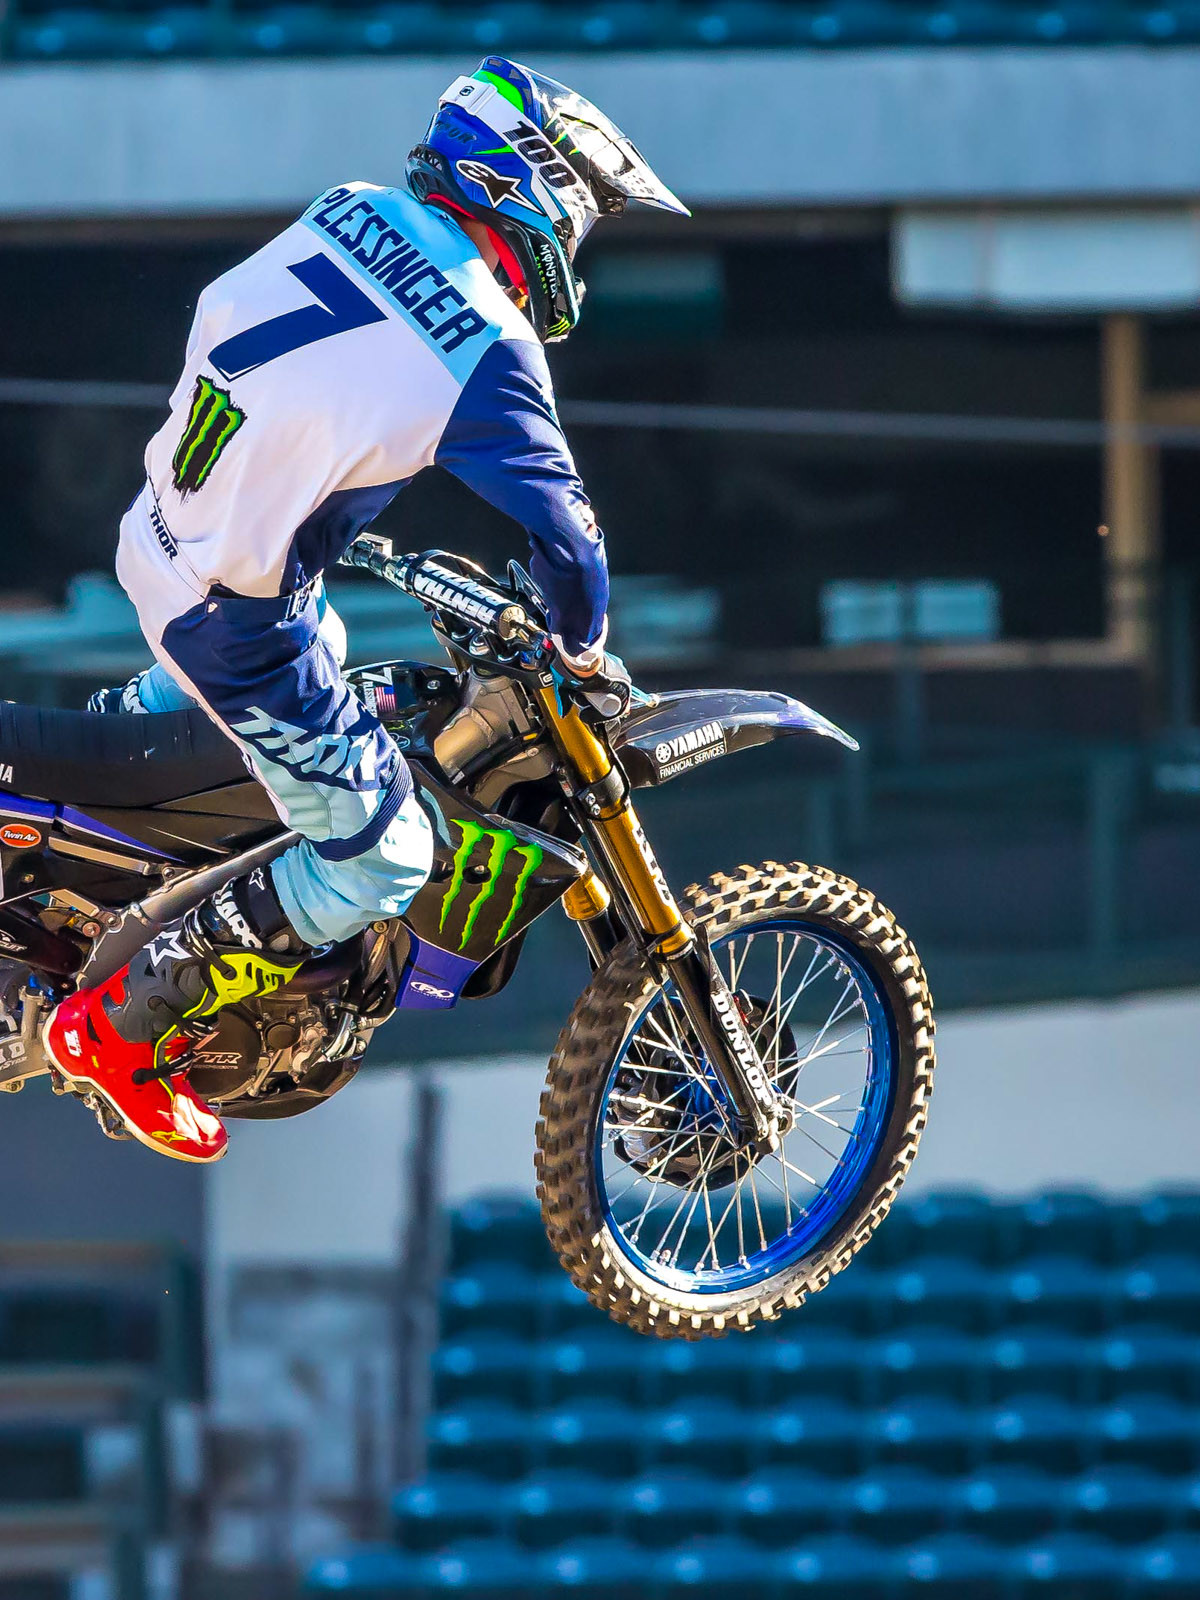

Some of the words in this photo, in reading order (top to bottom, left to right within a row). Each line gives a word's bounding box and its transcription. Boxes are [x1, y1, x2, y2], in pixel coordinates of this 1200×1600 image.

[312, 187, 489, 354] PLESSINGER
[208, 251, 389, 383] 7
[150, 505, 178, 561] THOR
[659, 757, 694, 780] FINANCIAL
[694, 744, 725, 765] SERVICES
[670, 721, 723, 758] YAMAHA
[3, 830, 23, 841] Twin
[23, 832, 38, 842] Air
[710, 991, 773, 1106] DUNLOP
